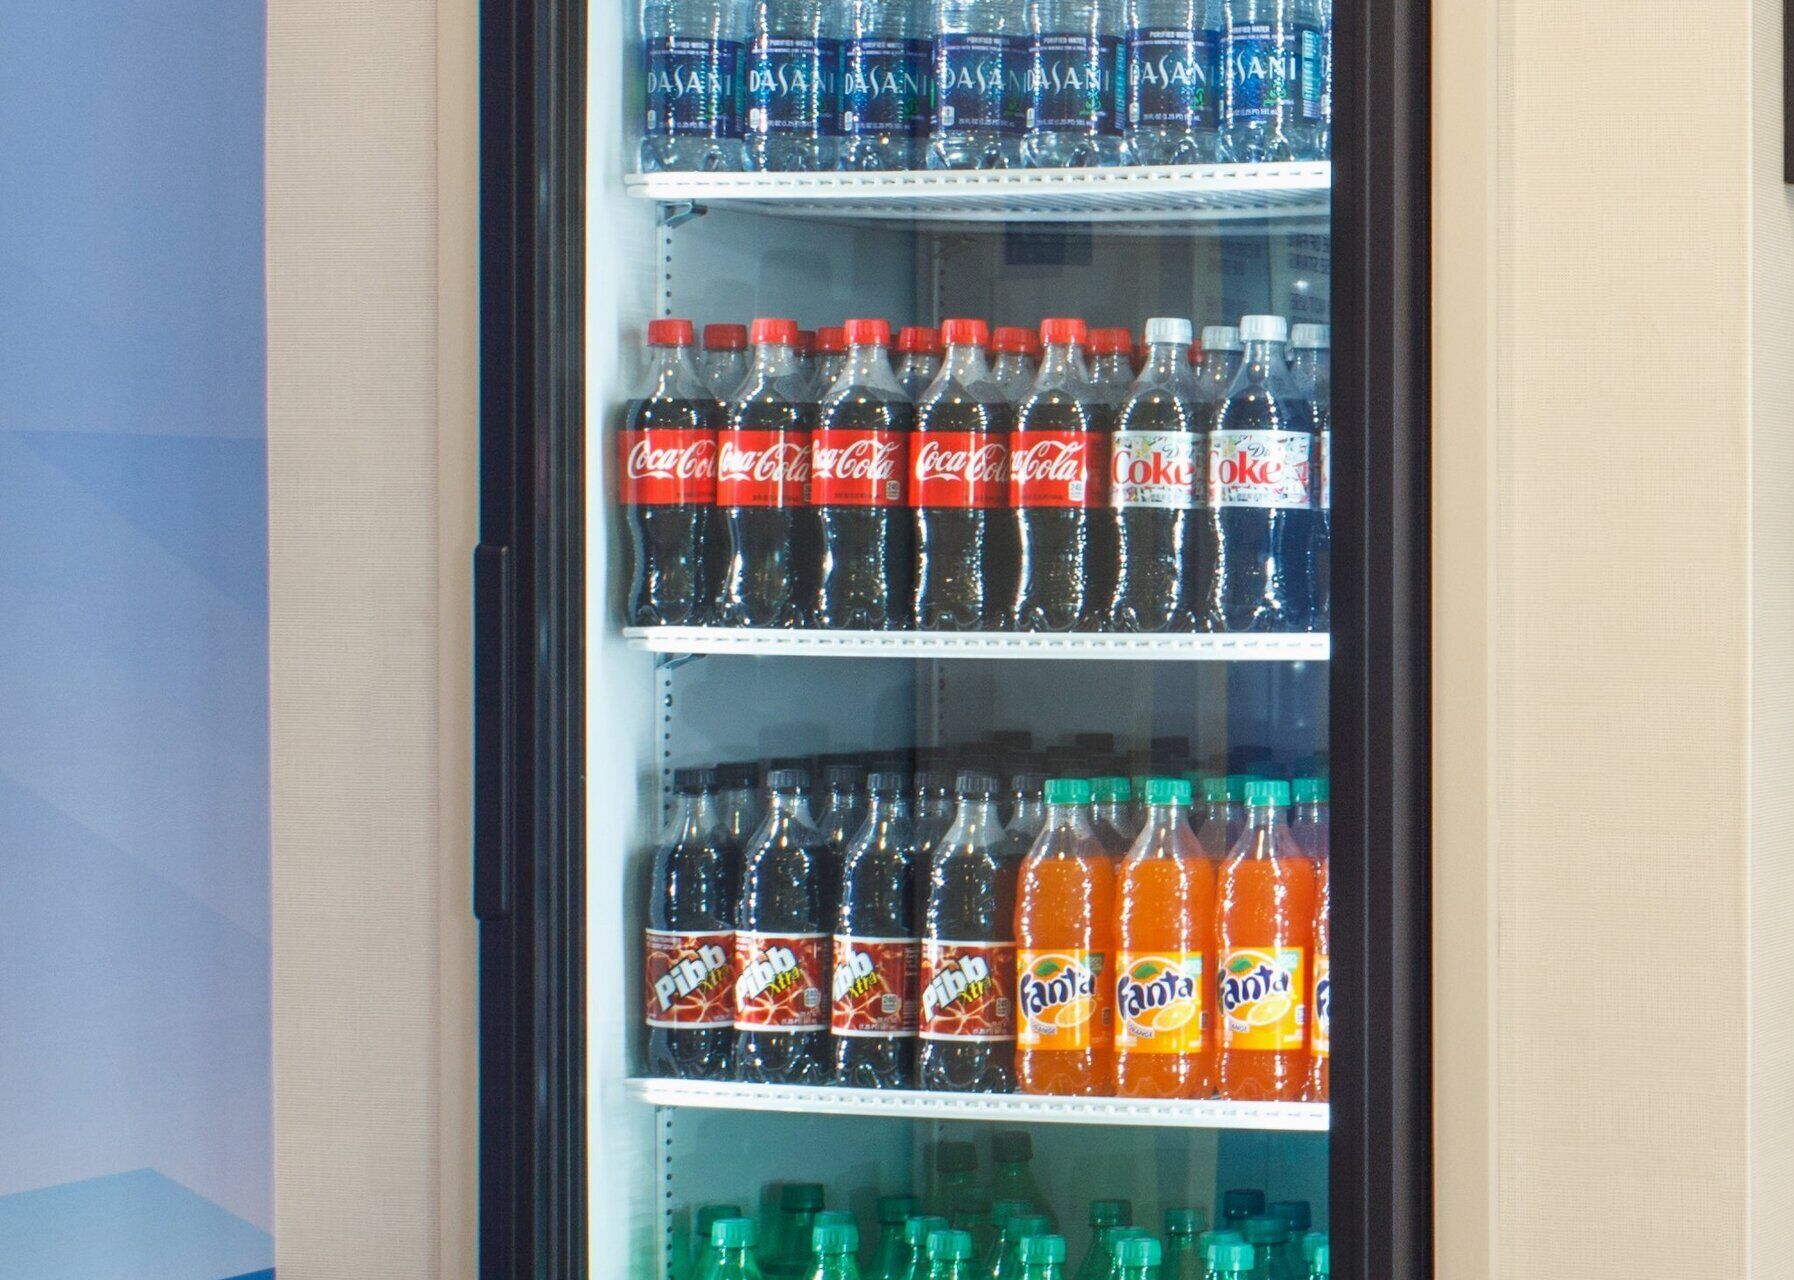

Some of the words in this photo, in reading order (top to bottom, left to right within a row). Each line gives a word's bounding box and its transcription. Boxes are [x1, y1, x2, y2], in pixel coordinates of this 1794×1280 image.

[648, 64, 732, 98] DASANI
[750, 63, 835, 97] DASANI
[845, 64, 927, 99] DASANI
[1027, 60, 1110, 96] DASANI
[1129, 54, 1215, 90] DASANI
[627, 439, 716, 480] Coca-Col
[915, 441, 1012, 483] Coca-Col
[1112, 450, 1196, 486] Coke
[654, 943, 728, 1013] Pibb
[735, 945, 797, 1014] Pibb
[832, 950, 875, 1003] ibb
[923, 954, 990, 1023] Pibb
[1020, 966, 1097, 1019] Fanta
[1117, 969, 1194, 1021] Fanta
